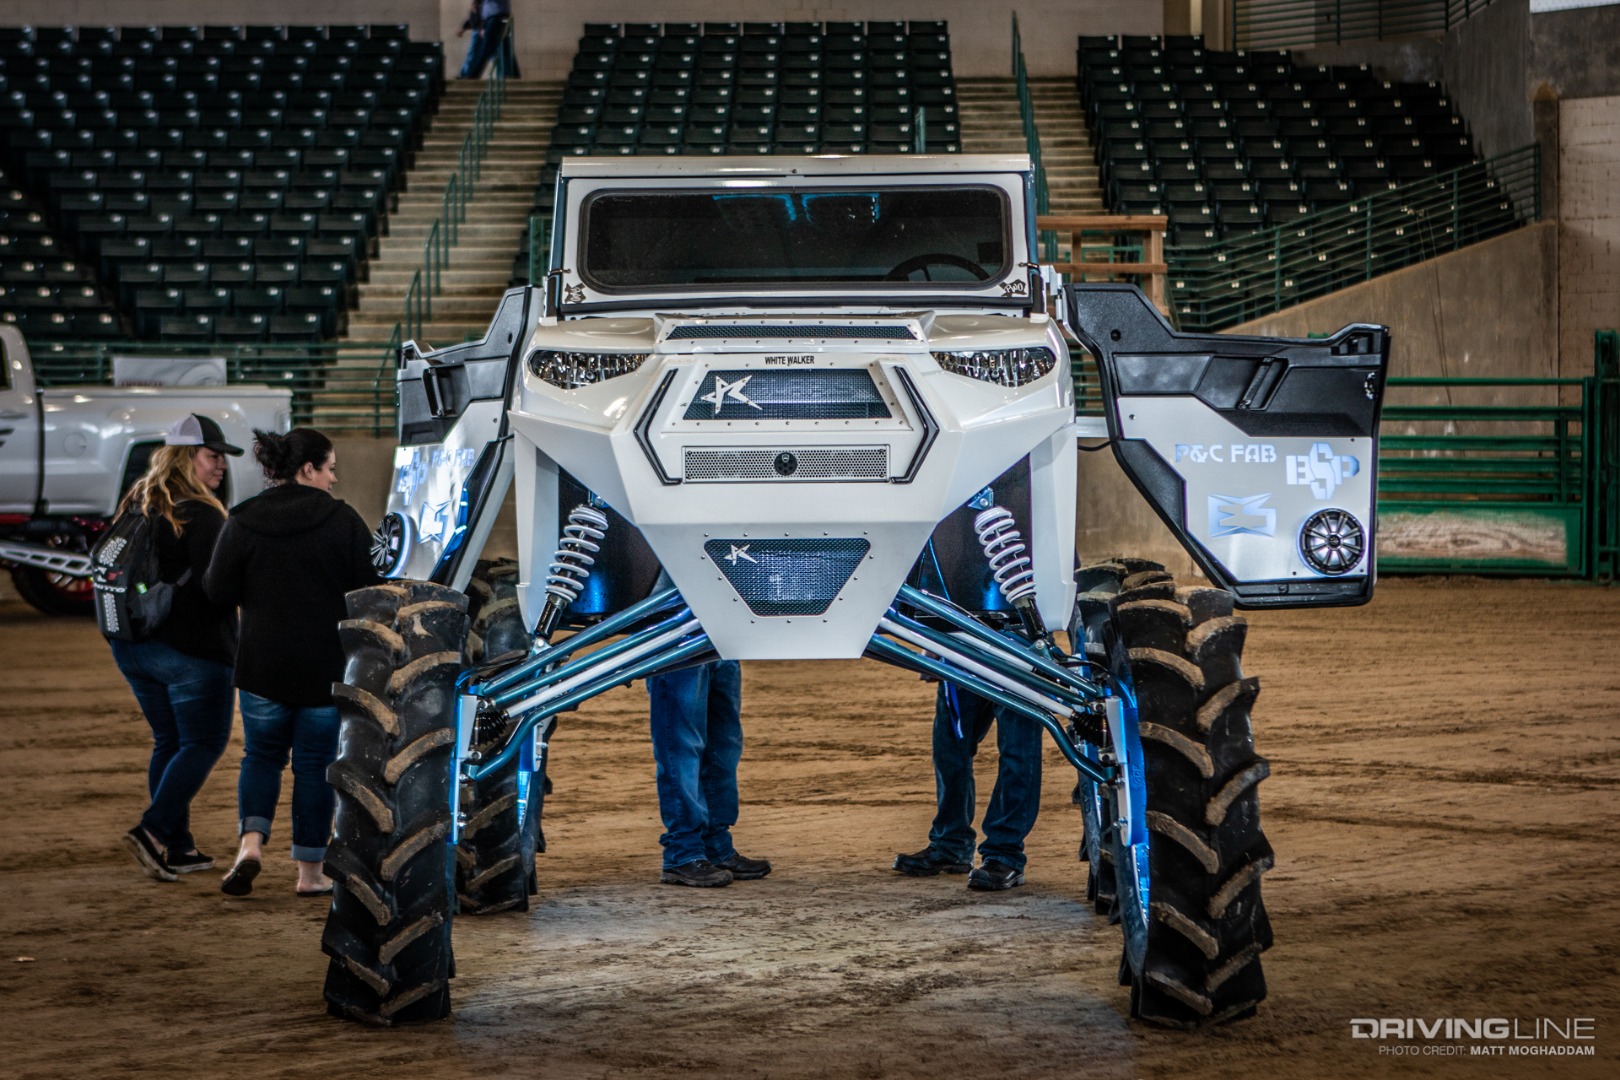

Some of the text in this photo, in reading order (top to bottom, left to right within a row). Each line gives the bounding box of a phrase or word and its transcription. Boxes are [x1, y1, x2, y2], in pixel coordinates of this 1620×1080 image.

[765, 355, 815, 366] WHITE WALKER
[1175, 444, 1277, 463] P&C FAB
